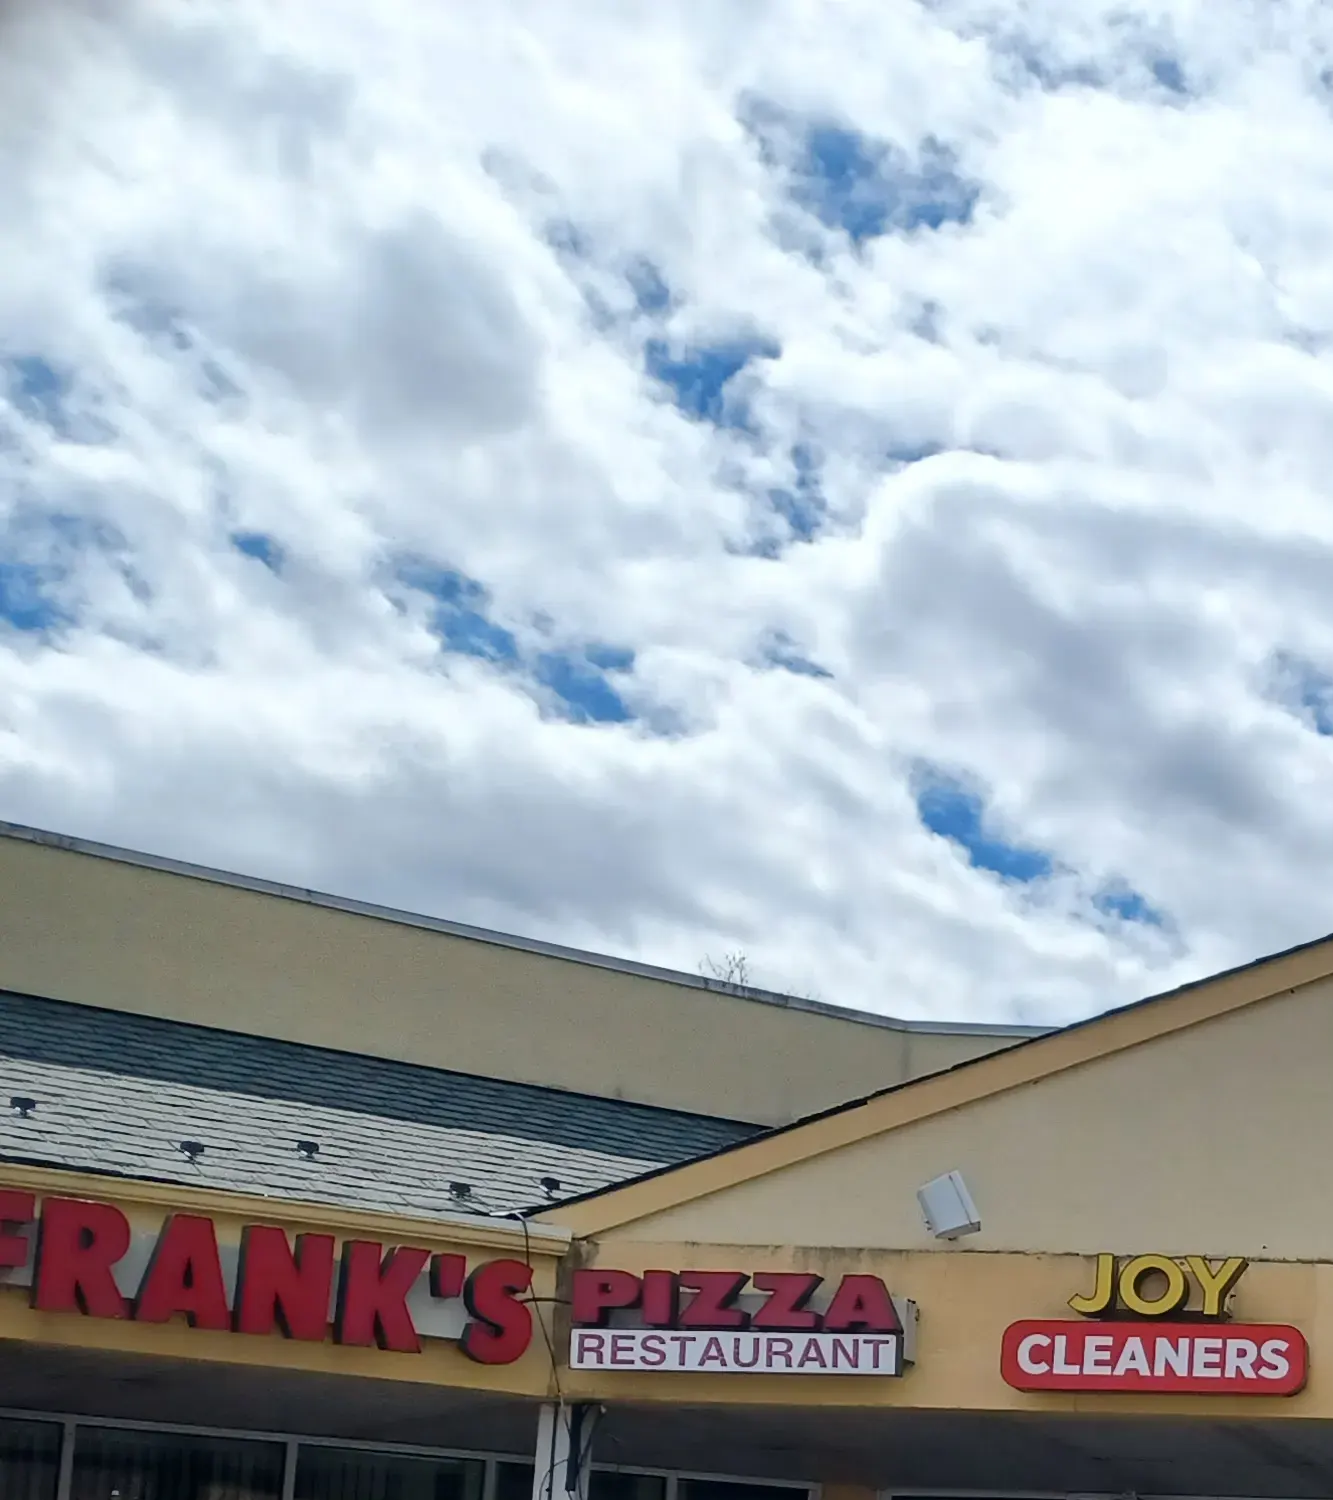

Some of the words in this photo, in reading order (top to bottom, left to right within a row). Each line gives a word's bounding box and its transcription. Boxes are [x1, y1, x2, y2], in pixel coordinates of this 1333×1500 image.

[572, 1269, 904, 1331] PIZZA
[1067, 1253, 1248, 1316] JOY
[576, 1333, 891, 1369] RESTAURANT
[1016, 1333, 1290, 1380] CLEANERS
